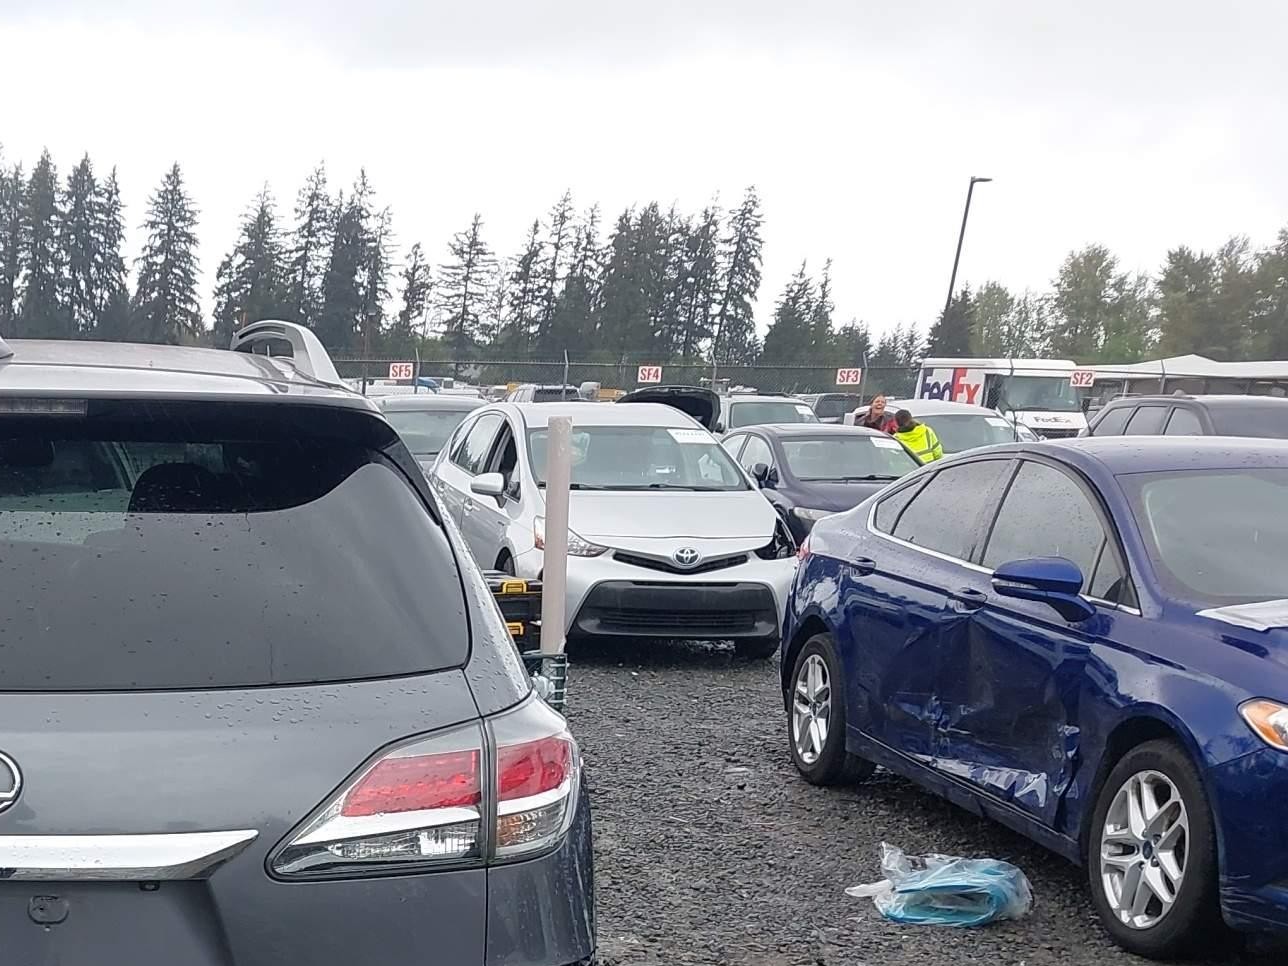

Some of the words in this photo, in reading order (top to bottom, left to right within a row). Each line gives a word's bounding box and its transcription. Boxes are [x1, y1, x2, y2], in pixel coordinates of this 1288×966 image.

[391, 364, 412, 378] SF5
[639, 367, 660, 381] SF4
[838, 370, 859, 383] SF3
[1072, 371, 1093, 385] SF2
[920, 368, 980, 405] FedEx
